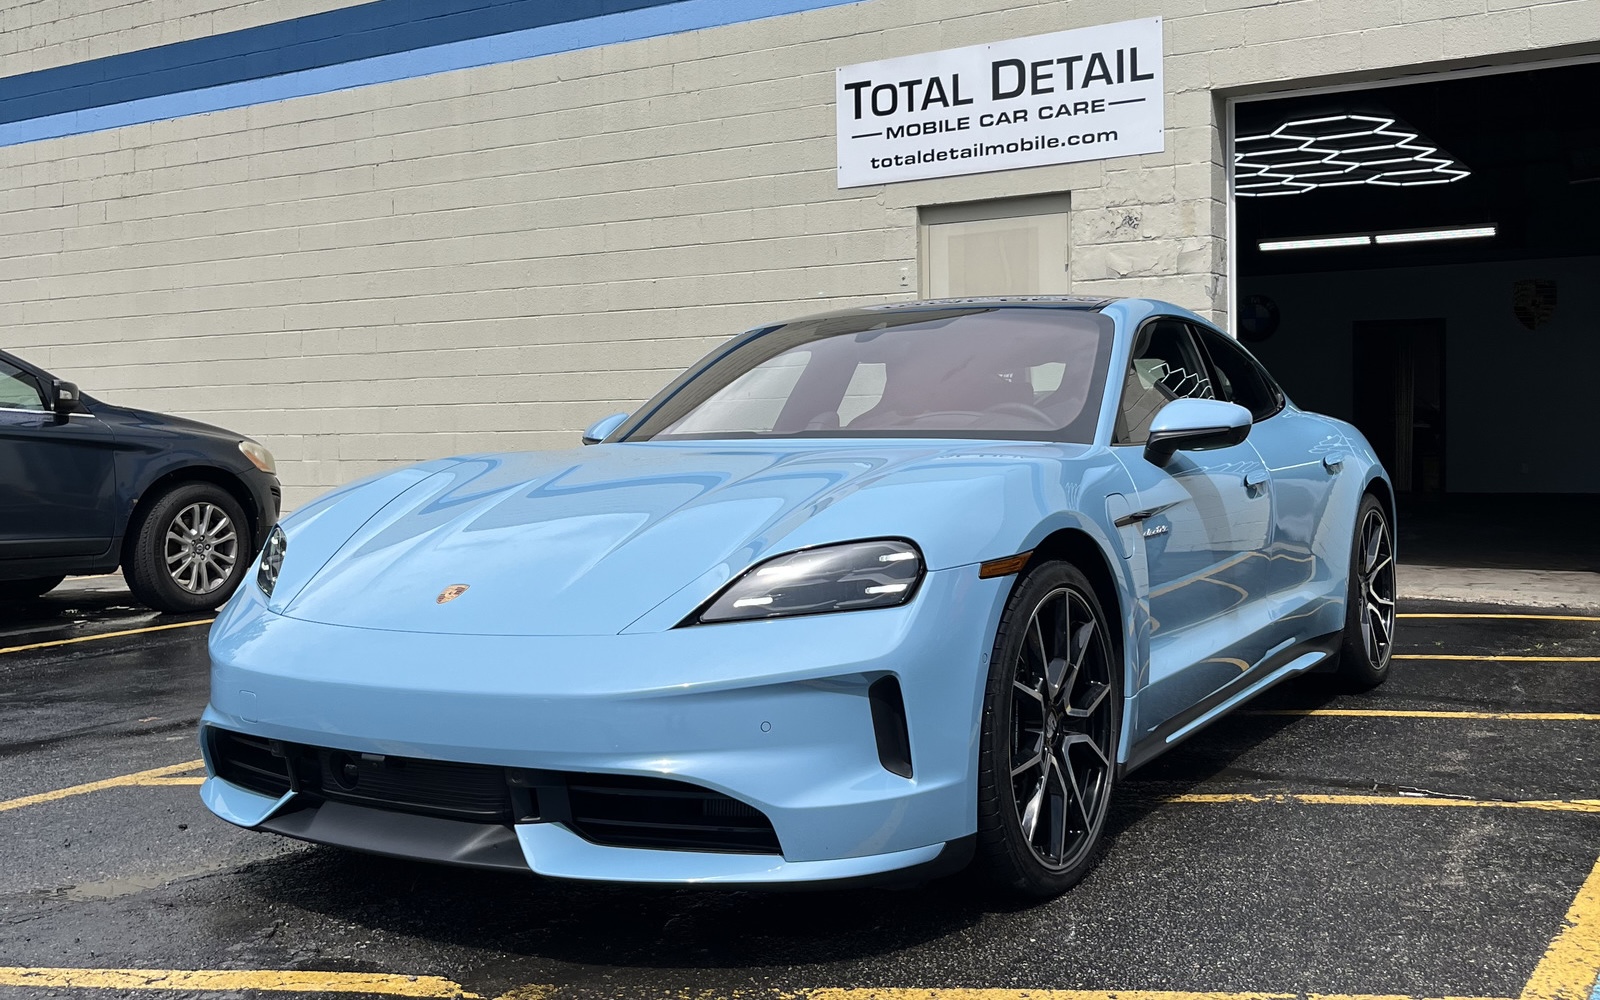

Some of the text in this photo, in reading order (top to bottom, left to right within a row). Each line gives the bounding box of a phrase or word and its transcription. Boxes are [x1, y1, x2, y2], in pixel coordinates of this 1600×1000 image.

[844, 46, 1155, 120] TOTAL DETAIL
[886, 98, 1106, 140] MOBILE CAR CARE
[870, 129, 1119, 169] totaldetailmobile.com
